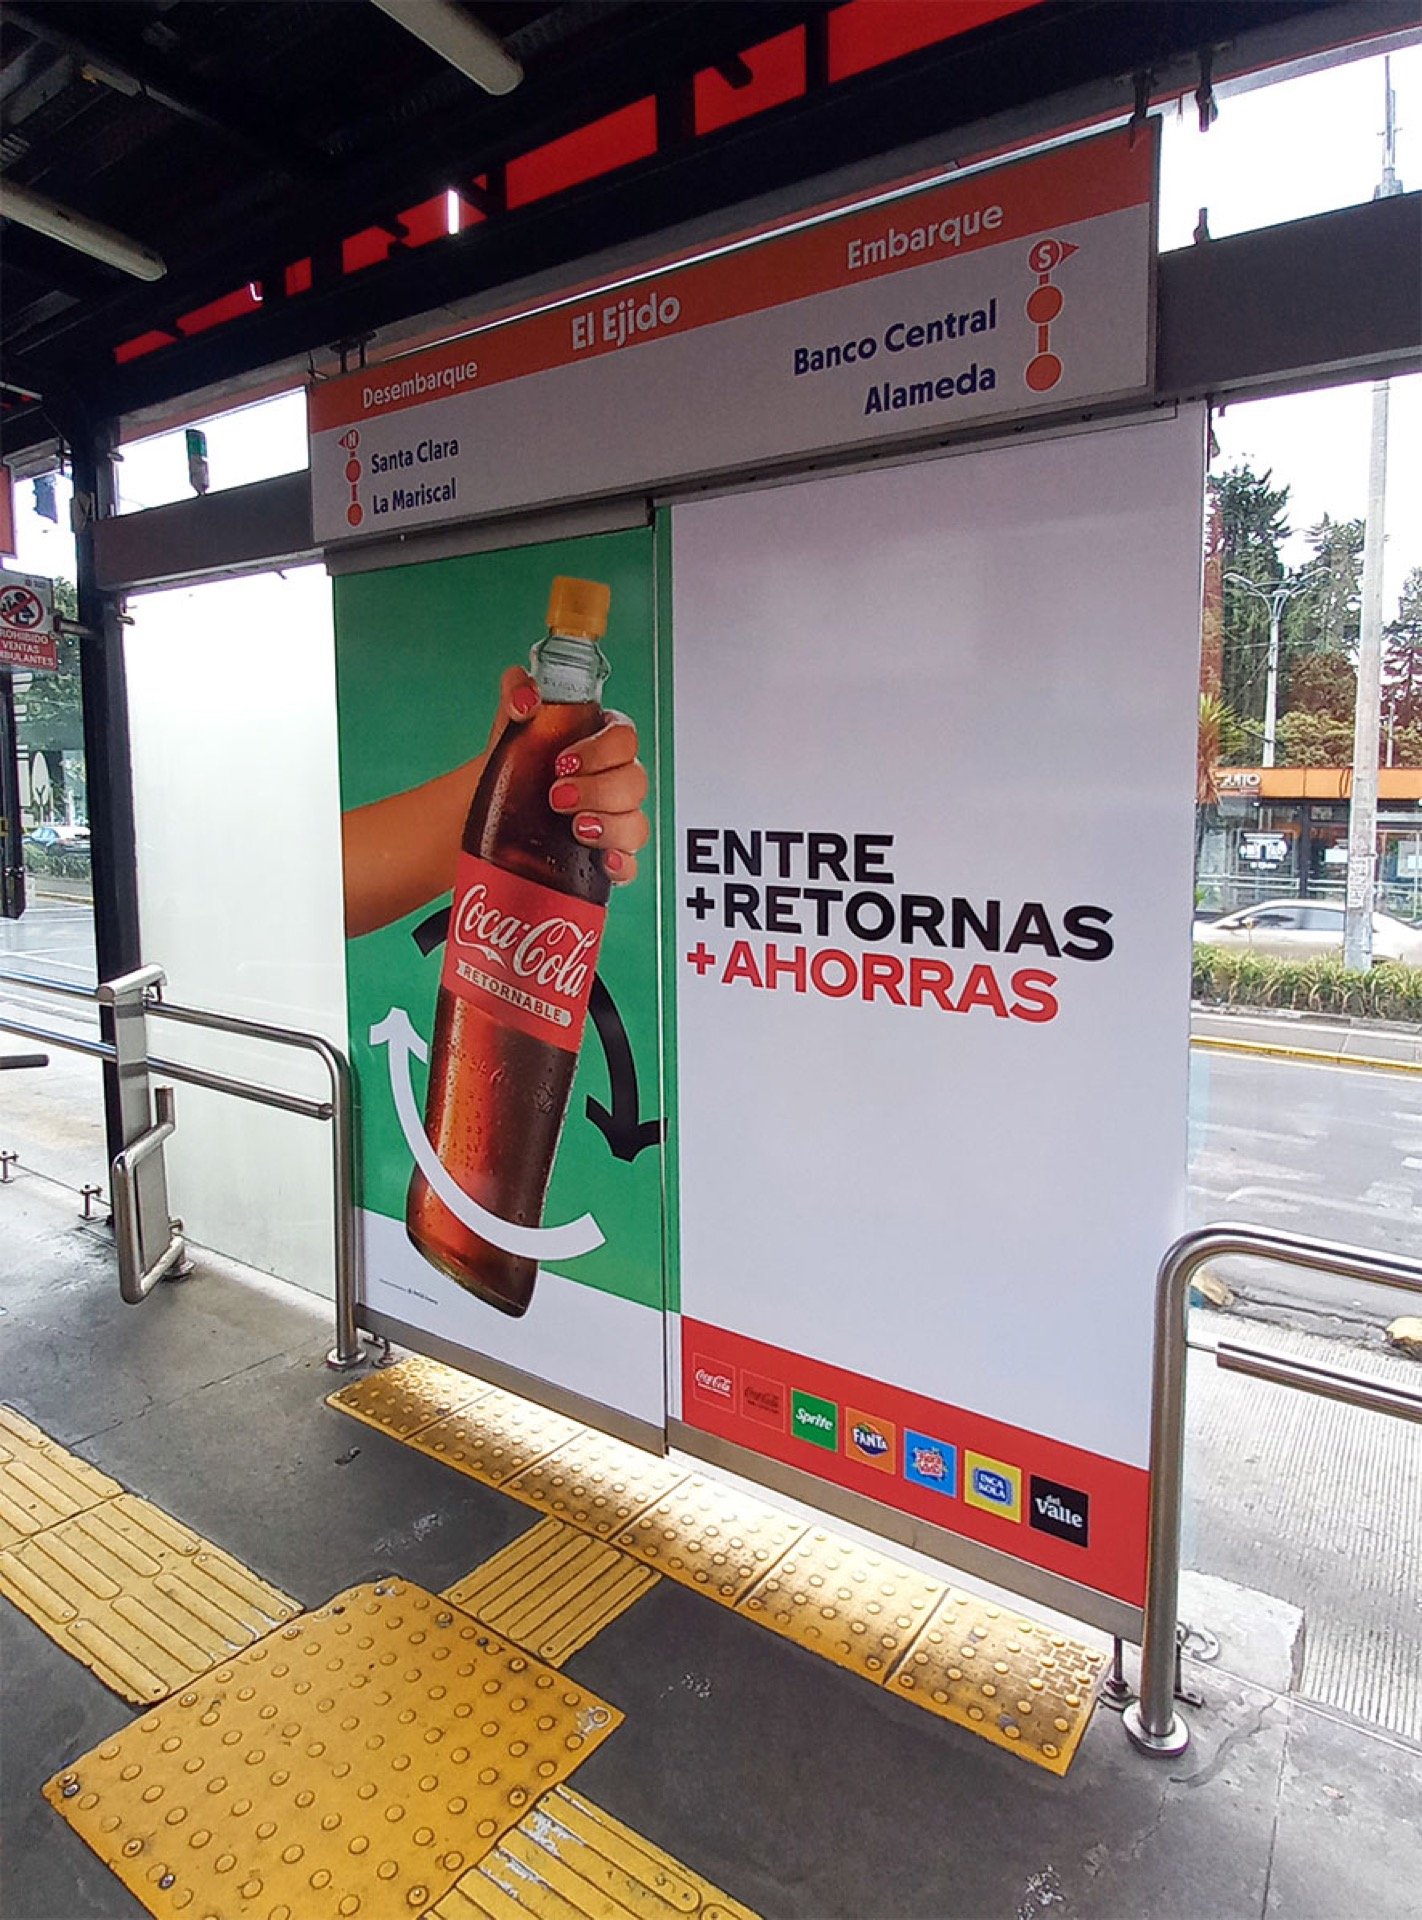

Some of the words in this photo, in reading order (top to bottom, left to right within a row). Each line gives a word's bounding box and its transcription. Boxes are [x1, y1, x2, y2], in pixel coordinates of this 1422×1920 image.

[847, 205, 1004, 270] Embarque
[571, 311, 595, 350] El
[602, 293, 681, 347] Ejido
[794, 336, 877, 376] Banco
[884, 298, 998, 353] Central
[362, 361, 478, 408] Desembarque
[864, 364, 996, 415] Alameda
[371, 450, 413, 474] Santa
[417, 439, 459, 463] Clara
[373, 494, 389, 515] La
[392, 477, 457, 511] Mariscal
[2, 639, 40, 654] VENTAS
[686, 828, 895, 884] ENTRE
[455, 884, 597, 997] Coca-Cola
[463, 963, 563, 1023] RETORNABLE
[795, 1407, 834, 1431] Sprite
[1034, 1497, 1083, 1528] Valle
